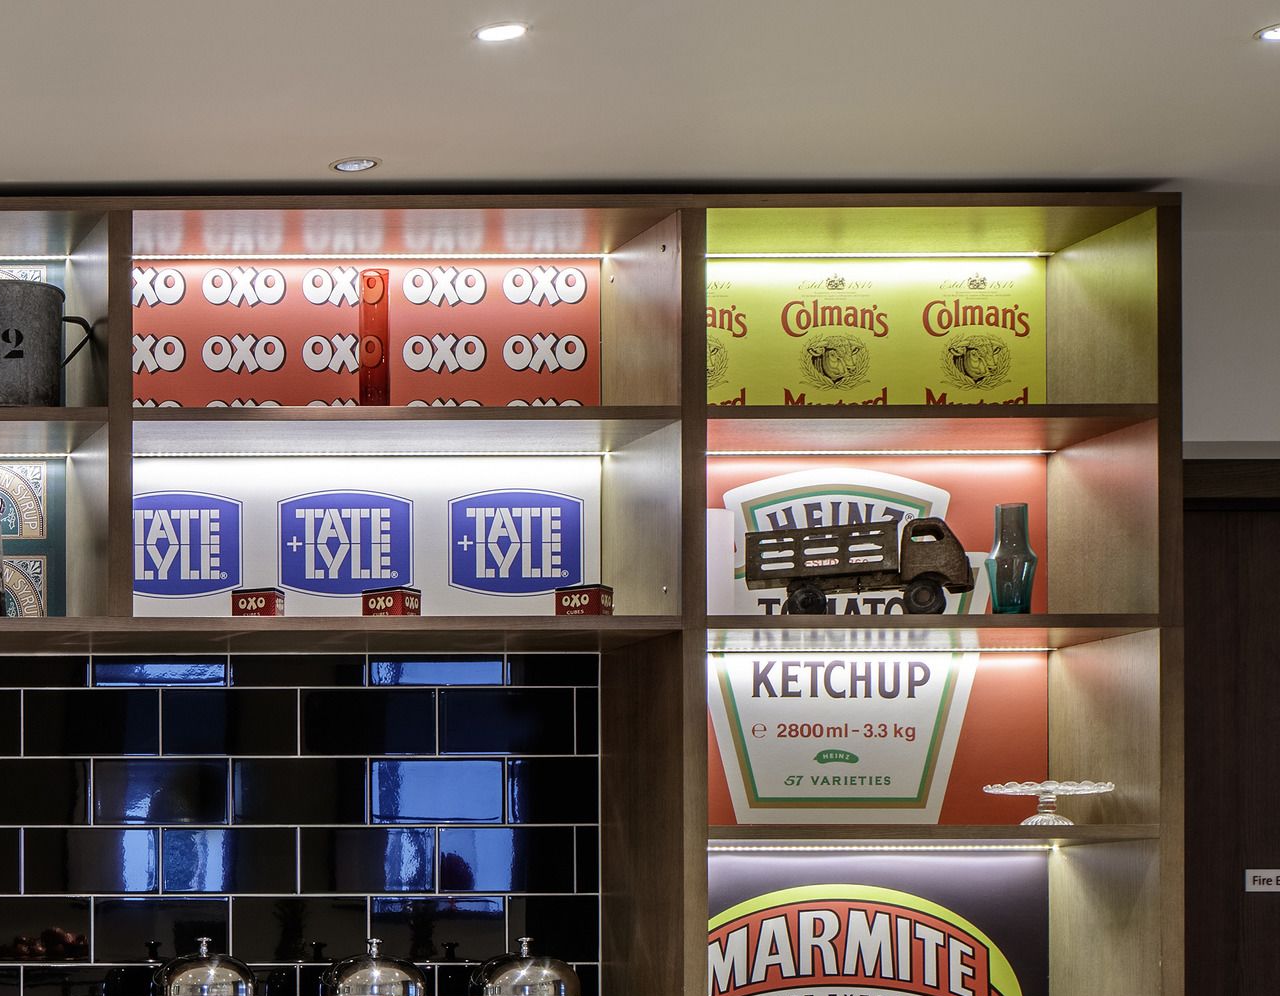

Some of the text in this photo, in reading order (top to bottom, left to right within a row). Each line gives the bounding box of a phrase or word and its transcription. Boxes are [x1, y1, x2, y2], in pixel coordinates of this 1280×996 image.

[202, 266, 286, 308] OXO
[402, 266, 486, 308] OXO
[780, 299, 889, 338] Colman's
[922, 299, 1030, 338] Colman's
[1, 328, 24, 359] 2
[503, 332, 586, 374] OXO
[296, 508, 391, 544] TATE
[466, 507, 561, 542] TATE
[305, 544, 391, 579] LYLE
[475, 543, 561, 578] LYLE
[238, 596, 266, 610] OXO
[368, 596, 394, 610] OXO
[561, 593, 590, 607] OXO
[752, 660, 931, 698] KETCHUP
[784, 775, 891, 786] 57 VARIETIES
[1252, 876, 1272, 885] Fire
